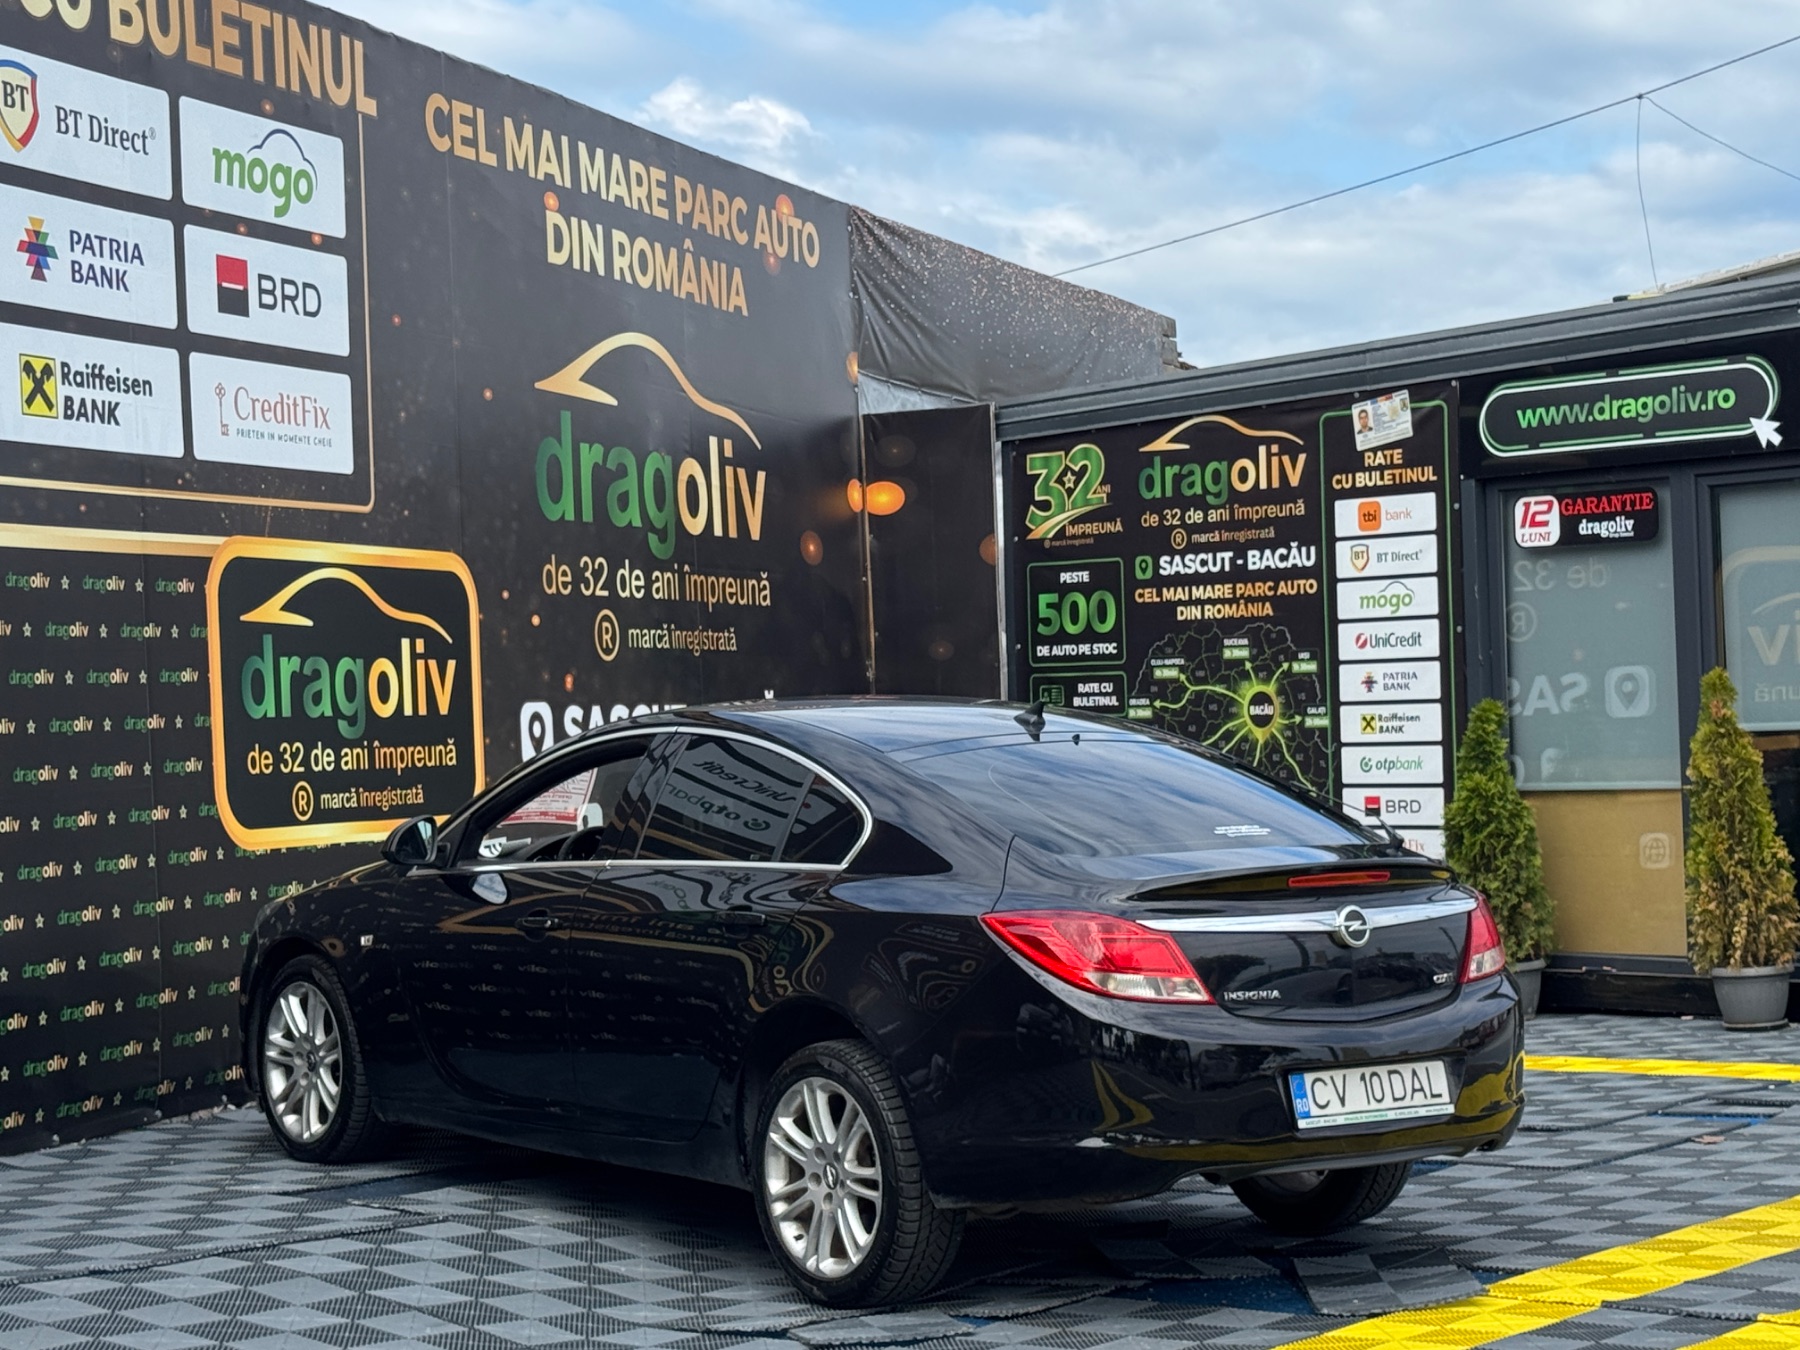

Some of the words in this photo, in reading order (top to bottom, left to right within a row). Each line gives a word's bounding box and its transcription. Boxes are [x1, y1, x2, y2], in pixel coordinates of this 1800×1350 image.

[1, 81, 29, 112] BT
[55, 105, 82, 138] BT
[212, 147, 314, 217] mogo
[425, 93, 497, 167] CEL
[504, 116, 571, 189] MAI
[578, 141, 669, 221] MARE
[675, 176, 749, 246] PARC
[754, 204, 820, 268] AUTO
[69, 230, 145, 266] PATRIA
[545, 210, 605, 277] DIN
[613, 238, 749, 316] ROMÂNIA
[70, 260, 130, 292] BANK
[257, 273, 322, 317] BRD
[60, 361, 153, 397] Raiffeisen
[62, 396, 121, 426] BANK
[234, 386, 331, 430] CreditFix
[1516, 385, 1736, 429] www.dragoliv.ro
[236, 428, 265, 440] PRIETEN
[268, 432, 275, 441] IN
[278, 434, 311, 445] MOMENTE
[314, 437, 332, 448] CHEIE
[1364, 449, 1403, 467] RATE
[536, 410, 766, 559] dragoliv
[1025, 443, 1107, 530] 32
[1138, 444, 1307, 506] dragoliv
[1332, 474, 1352, 490] CU
[1355, 466, 1438, 488] BULETINUL
[1096, 484, 1111, 493] ANI
[1141, 511, 1159, 527] de
[1163, 509, 1181, 526] 32
[1185, 507, 1203, 524] de
[1208, 506, 1229, 522] ani
[1234, 499, 1305, 523] împreună
[1362, 509, 1378, 522] tbi
[1385, 508, 1412, 521] bank
[1520, 499, 1553, 530] 12
[1561, 492, 1654, 516] GARANTIE
[1065, 517, 1123, 536] ÎMPREUNĂ
[1192, 529, 1220, 544] marcă
[1221, 526, 1275, 543] înregistrată
[1521, 531, 1552, 544] LUNI
[1579, 516, 1634, 538] dragoliv
[1159, 551, 1233, 576] SASCUT
[1247, 541, 1316, 571] BACĂU
[1354, 550, 1365, 560] BT
[1377, 552, 1389, 563] BT
[5, 572, 50, 591] dragoliv
[82, 575, 125, 593] dragoliv
[155, 578, 195, 596] dragoliv
[543, 553, 572, 596] de
[580, 556, 609, 597] 32
[616, 559, 645, 600] de
[651, 563, 679, 600] ani
[684, 566, 771, 612] împreună
[1060, 571, 1090, 584] PESTE
[1135, 589, 1160, 603] CEL
[1163, 586, 1190, 601] MAI
[1192, 583, 1233, 600] MARE
[1236, 582, 1274, 598] PARC
[1277, 579, 1317, 596] AUTO
[1359, 592, 1413, 615] mogo
[1037, 590, 1117, 636] 500
[1177, 603, 1203, 620] DIN
[1205, 601, 1273, 619] ROMÂNIA
[45, 621, 89, 640] dragoliv
[120, 623, 161, 641] dragoliv
[628, 624, 669, 649] marcă
[671, 626, 737, 656] înregistrată
[1369, 632, 1422, 648] UniCredit
[1037, 645, 1051, 656] DE
[1052, 645, 1074, 656] AUTO
[1078, 644, 1090, 656] PE
[1092, 643, 1118, 654] STOC
[9, 668, 54, 688] dragoliv
[86, 668, 129, 687] dragoliv
[159, 667, 198, 686] dragoliv
[241, 633, 457, 740] dragoliv
[1077, 682, 1099, 693] RATE
[1100, 682, 1113, 692] CU
[1382, 672, 1418, 681] PATRIA
[1383, 682, 1411, 691] BANK
[1073, 696, 1119, 707] BULETINUL
[1249, 703, 1274, 715] BACĂU
[49, 716, 93, 735] dragoliv
[124, 714, 165, 732] dragoliv
[1378, 714, 1421, 723] Raiffeisen
[1379, 725, 1405, 734] BANK
[247, 744, 273, 775] de
[279, 742, 305, 773] 32
[311, 741, 335, 771] de
[341, 741, 369, 770] ani
[374, 738, 457, 776] împreună
[1376, 756, 1424, 774] otpbank
[13, 765, 58, 785] dragoliv
[90, 761, 133, 780] dragoliv
[163, 757, 203, 776] dragoliv
[320, 785, 358, 809] marcă
[359, 784, 424, 811] înregistrată
[1386, 800, 1421, 814] BRD
[53, 811, 97, 831] dragoliv
[128, 805, 170, 824] dragoliv
[17, 861, 62, 882] dragoliv
[95, 854, 138, 874] dragoliv
[167, 847, 207, 865] dragoliv
[58, 905, 102, 926] dragoliv
[133, 896, 174, 917] dragoliv
[204, 887, 241, 908] dragoliv
[22, 958, 66, 979] dragoliv
[99, 947, 142, 968] dragoliv
[172, 937, 213, 956] dragoliv
[60, 1000, 104, 1022] dragoliv
[136, 988, 178, 1009] dragoliv
[207, 976, 240, 997] dragoli
[23, 1055, 68, 1077] dragoliv
[100, 1041, 143, 1062] dragoliv
[172, 1027, 213, 1047] dragoliv
[1296, 1098, 1310, 1113] RO
[1311, 1074, 1346, 1110] CV
[1360, 1071, 1384, 1106] 10
[1387, 1066, 1442, 1103] DAL
[56, 1096, 103, 1118] dragoliv
